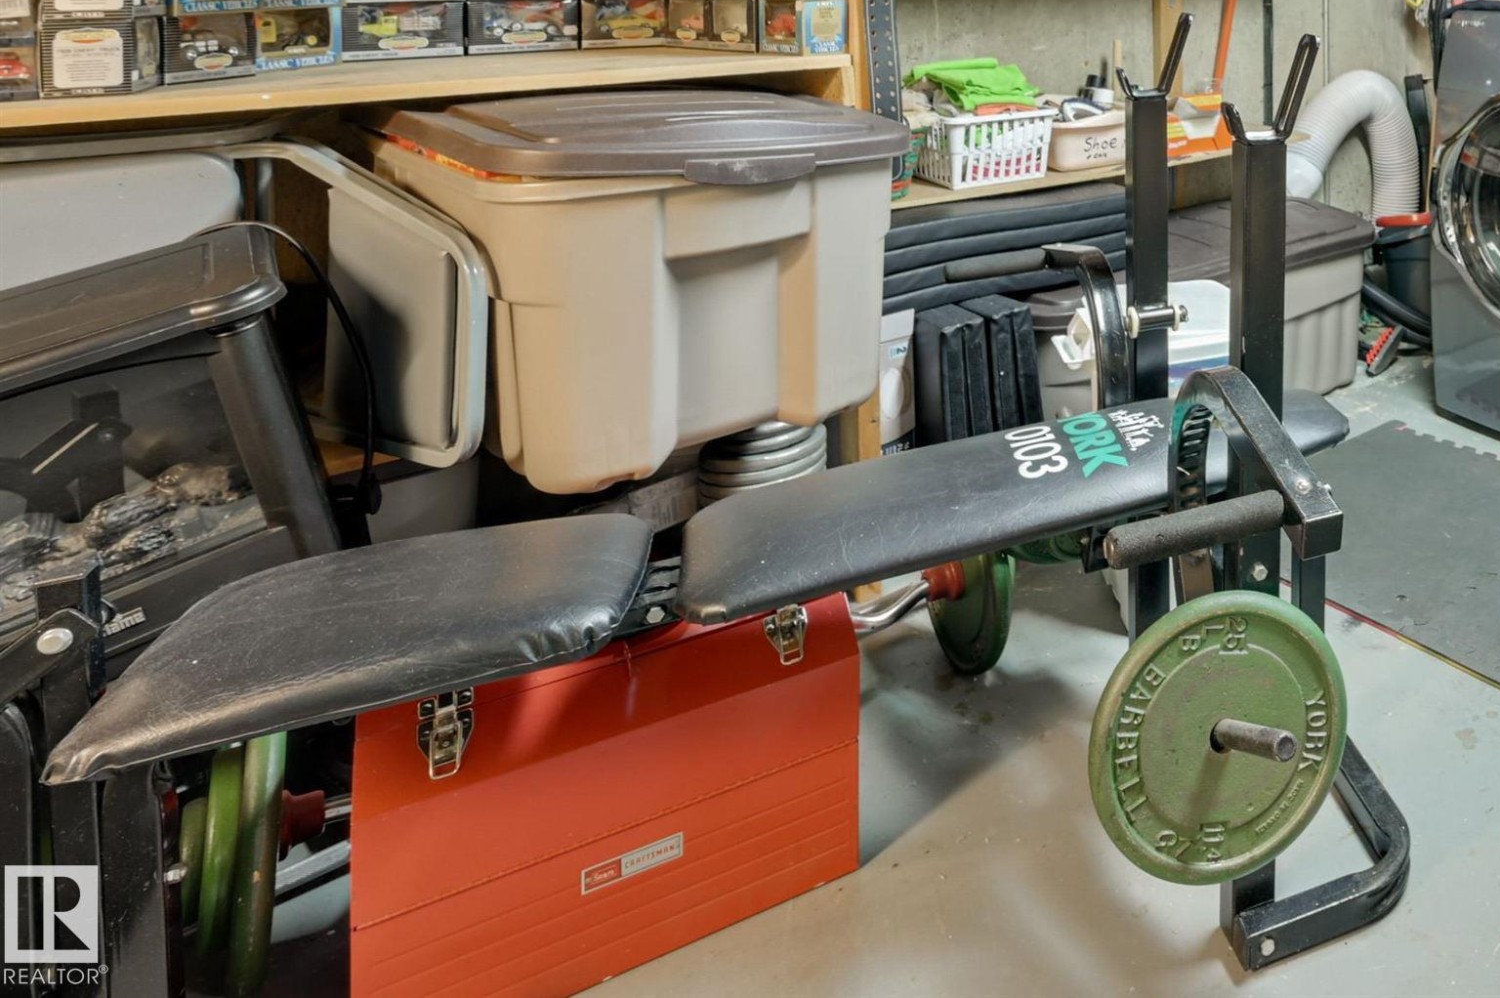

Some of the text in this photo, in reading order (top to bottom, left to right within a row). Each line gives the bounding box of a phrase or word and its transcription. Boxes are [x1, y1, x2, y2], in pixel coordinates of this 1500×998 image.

[1084, 135, 1118, 153] Shoe
[1004, 425, 1069, 479] 0103
[1115, 662, 1167, 827] BARBELL
[1297, 689, 1329, 772] YORK
